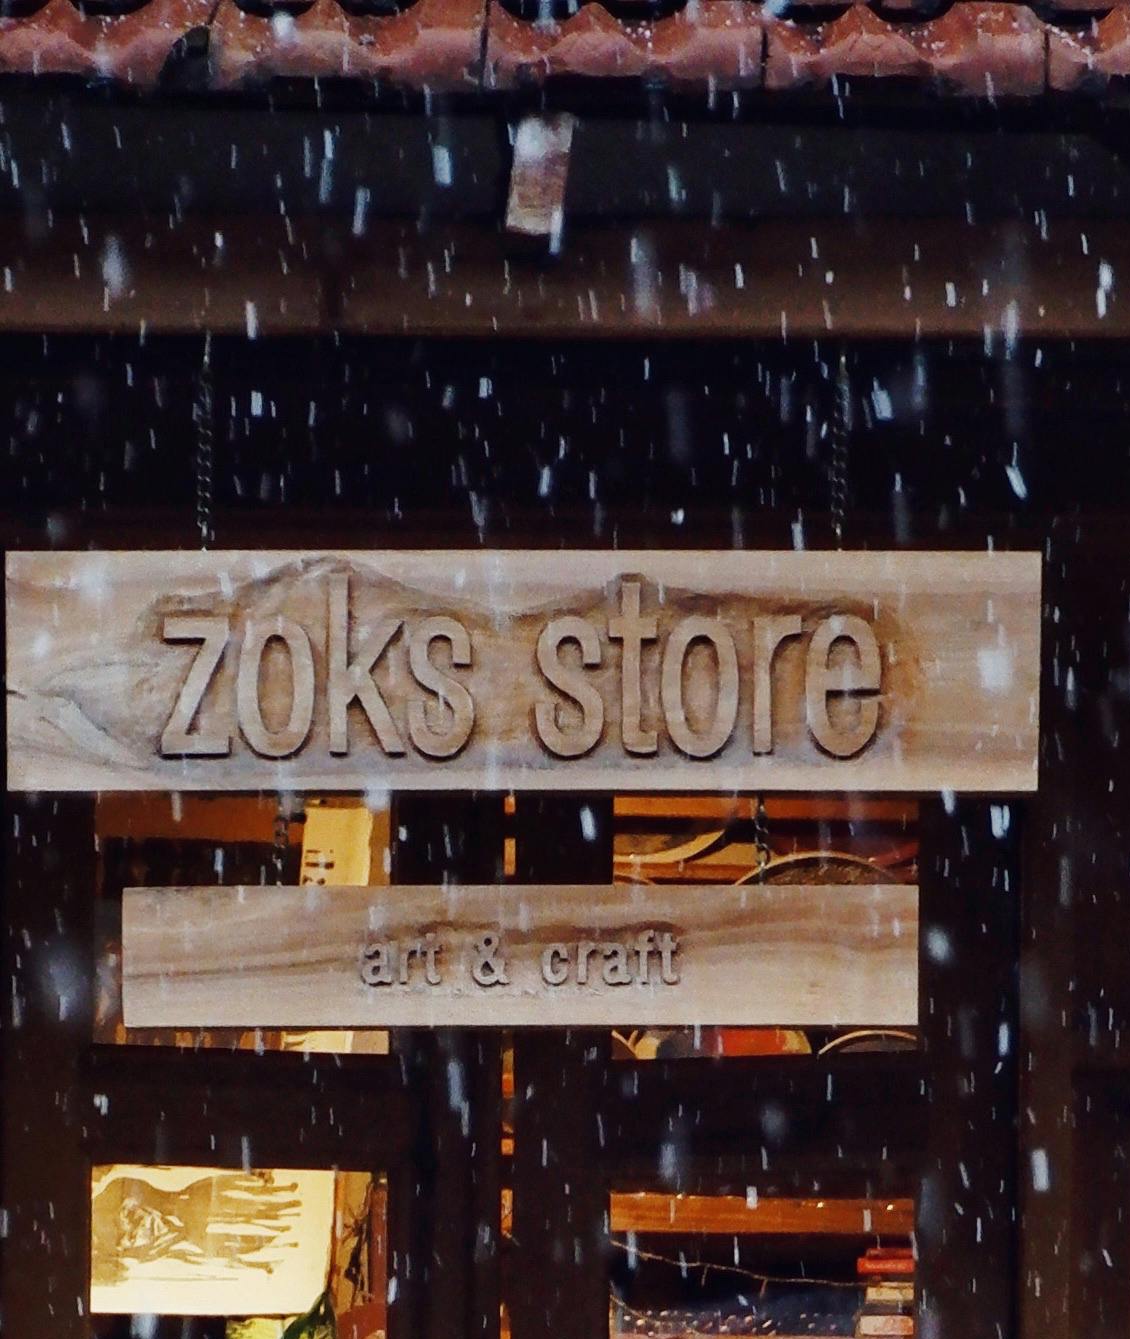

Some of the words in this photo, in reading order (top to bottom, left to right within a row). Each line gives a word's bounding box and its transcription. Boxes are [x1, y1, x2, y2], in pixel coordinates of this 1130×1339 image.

[160, 573, 476, 760] zoks
[533, 580, 882, 760] store
[362, 932, 442, 986] art
[472, 932, 509, 987] &
[541, 929, 681, 986] craft
